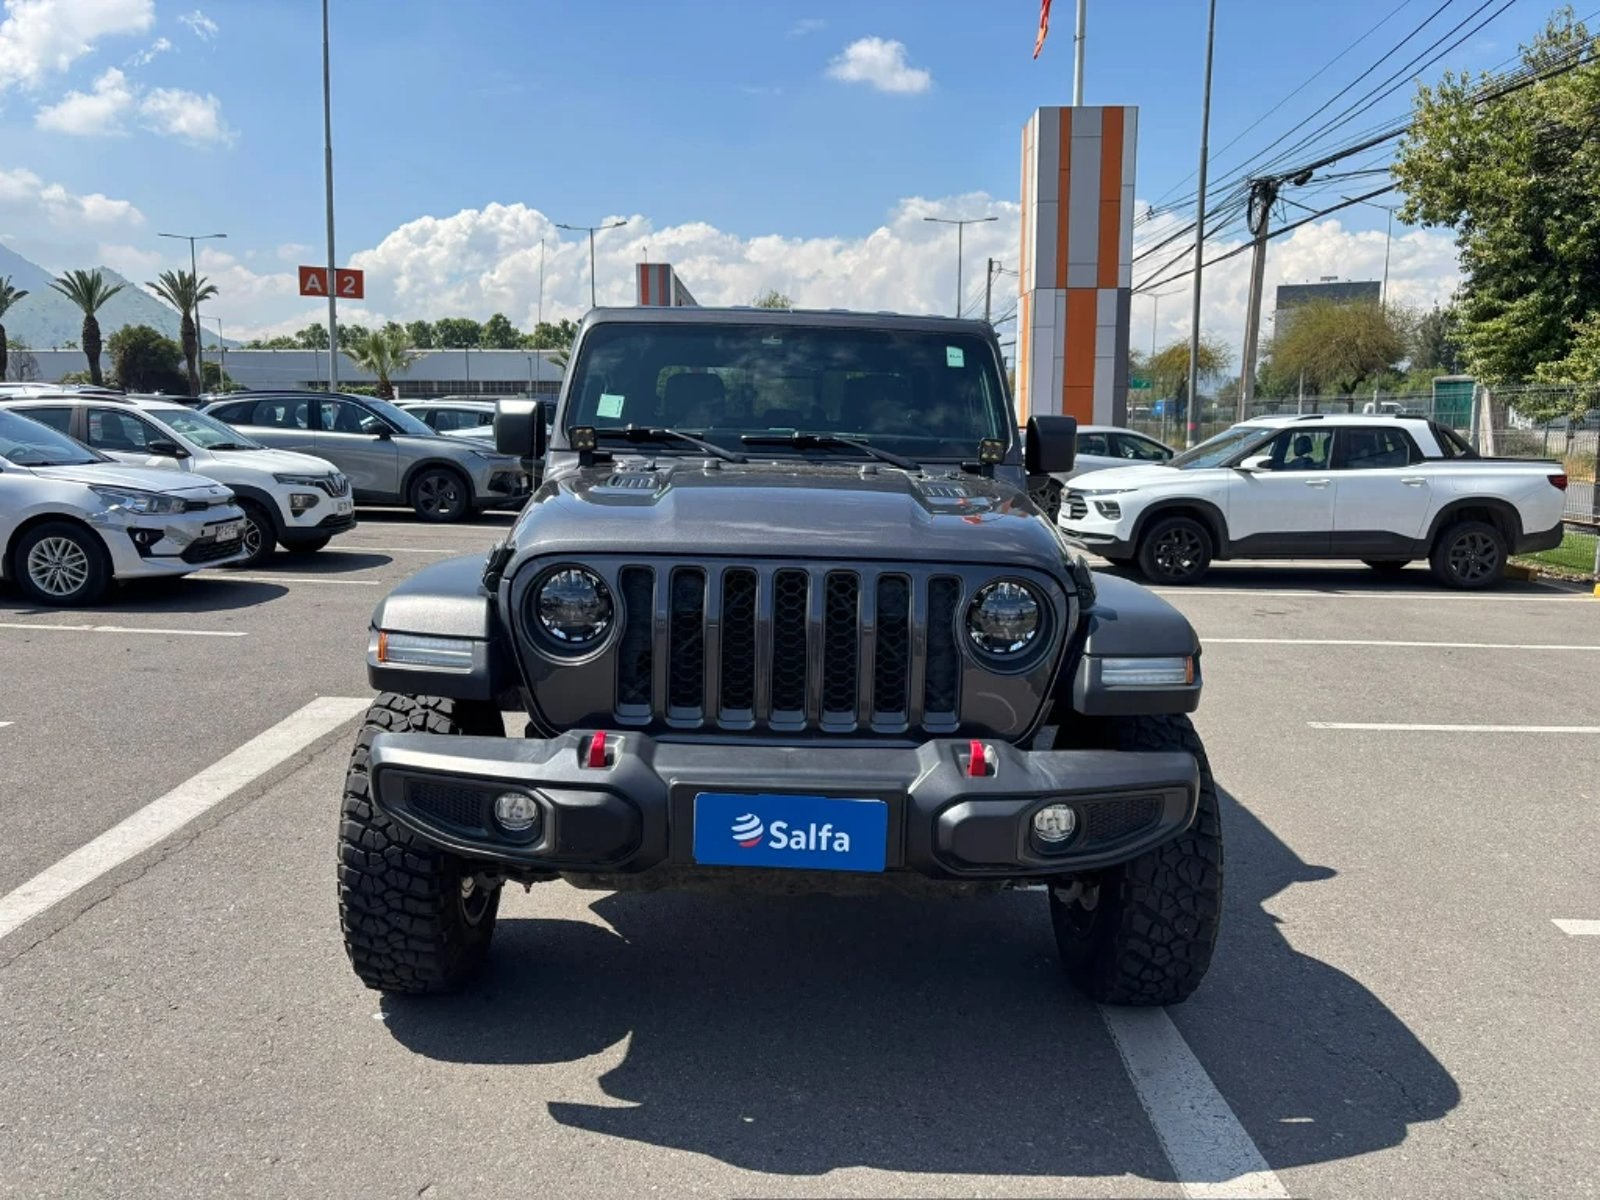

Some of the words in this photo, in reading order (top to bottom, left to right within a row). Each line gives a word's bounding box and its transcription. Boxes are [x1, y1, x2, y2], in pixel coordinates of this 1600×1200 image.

[304, 272, 323, 292] A
[343, 275, 356, 294] 2
[768, 820, 850, 852] Salfa
